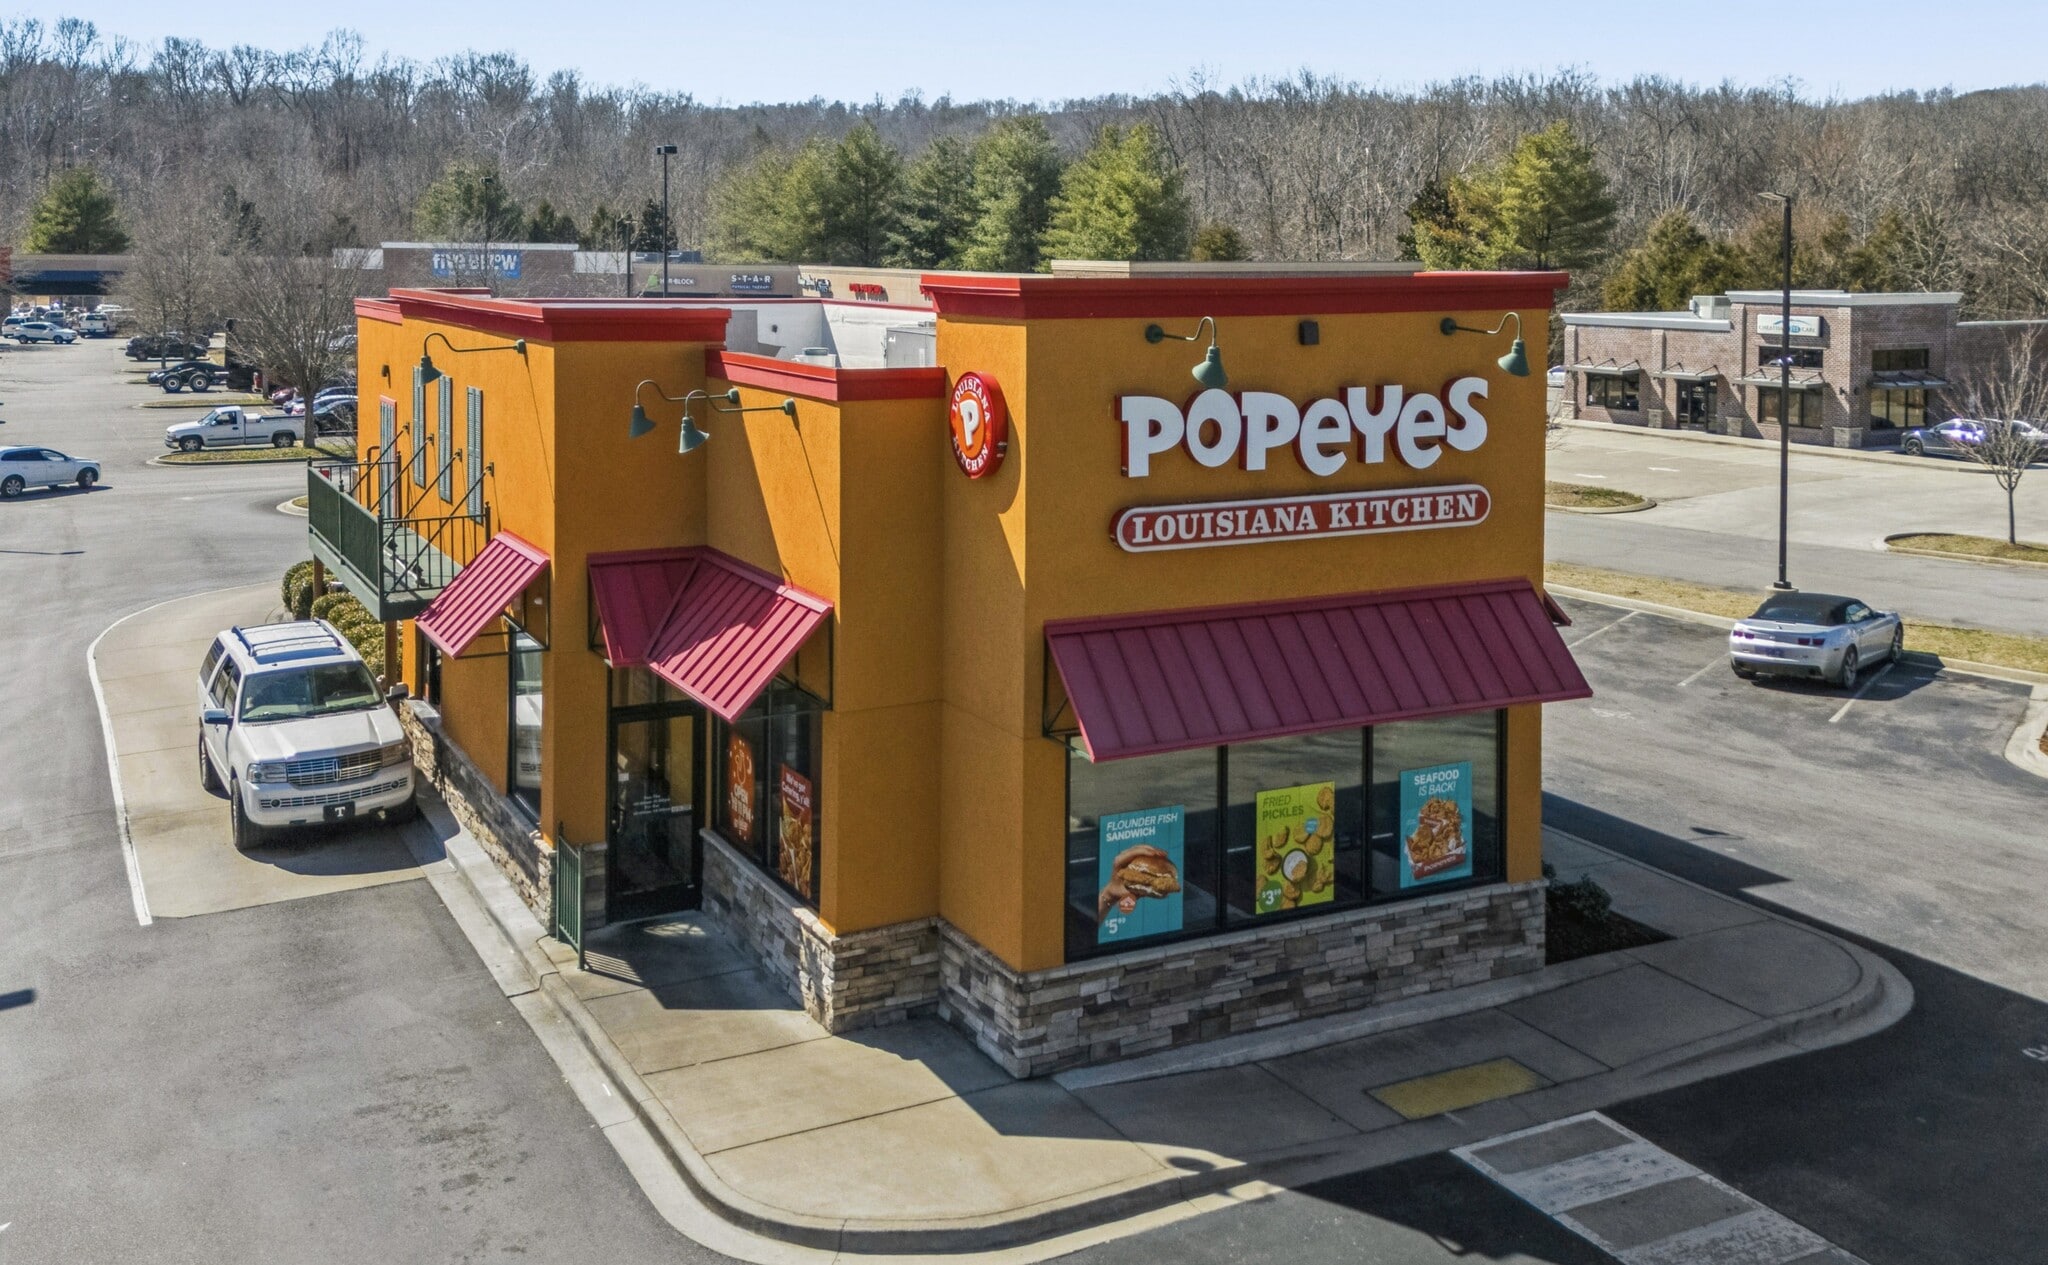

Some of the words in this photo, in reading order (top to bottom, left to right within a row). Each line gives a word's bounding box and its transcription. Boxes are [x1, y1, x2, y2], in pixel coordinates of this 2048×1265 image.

[952, 379, 991, 423] LOUISIANA
[960, 400, 979, 446] P
[953, 436, 989, 470] KITCHEN
[1132, 505, 1318, 544] LOUISIANA
[1329, 494, 1478, 528] KITCHEN
[1414, 769, 1459, 786] SEAFOOD
[1418, 785, 1427, 797] IS
[1429, 781, 1456, 795] BACK!
[1263, 794, 1291, 808] FRIED
[335, 806, 345, 817] T
[1262, 805, 1304, 820] PICKLES
[1106, 815, 1156, 831] FLOUNDER
[1158, 813, 1178, 825] FISH
[1106, 826, 1155, 842] SANDWICH
